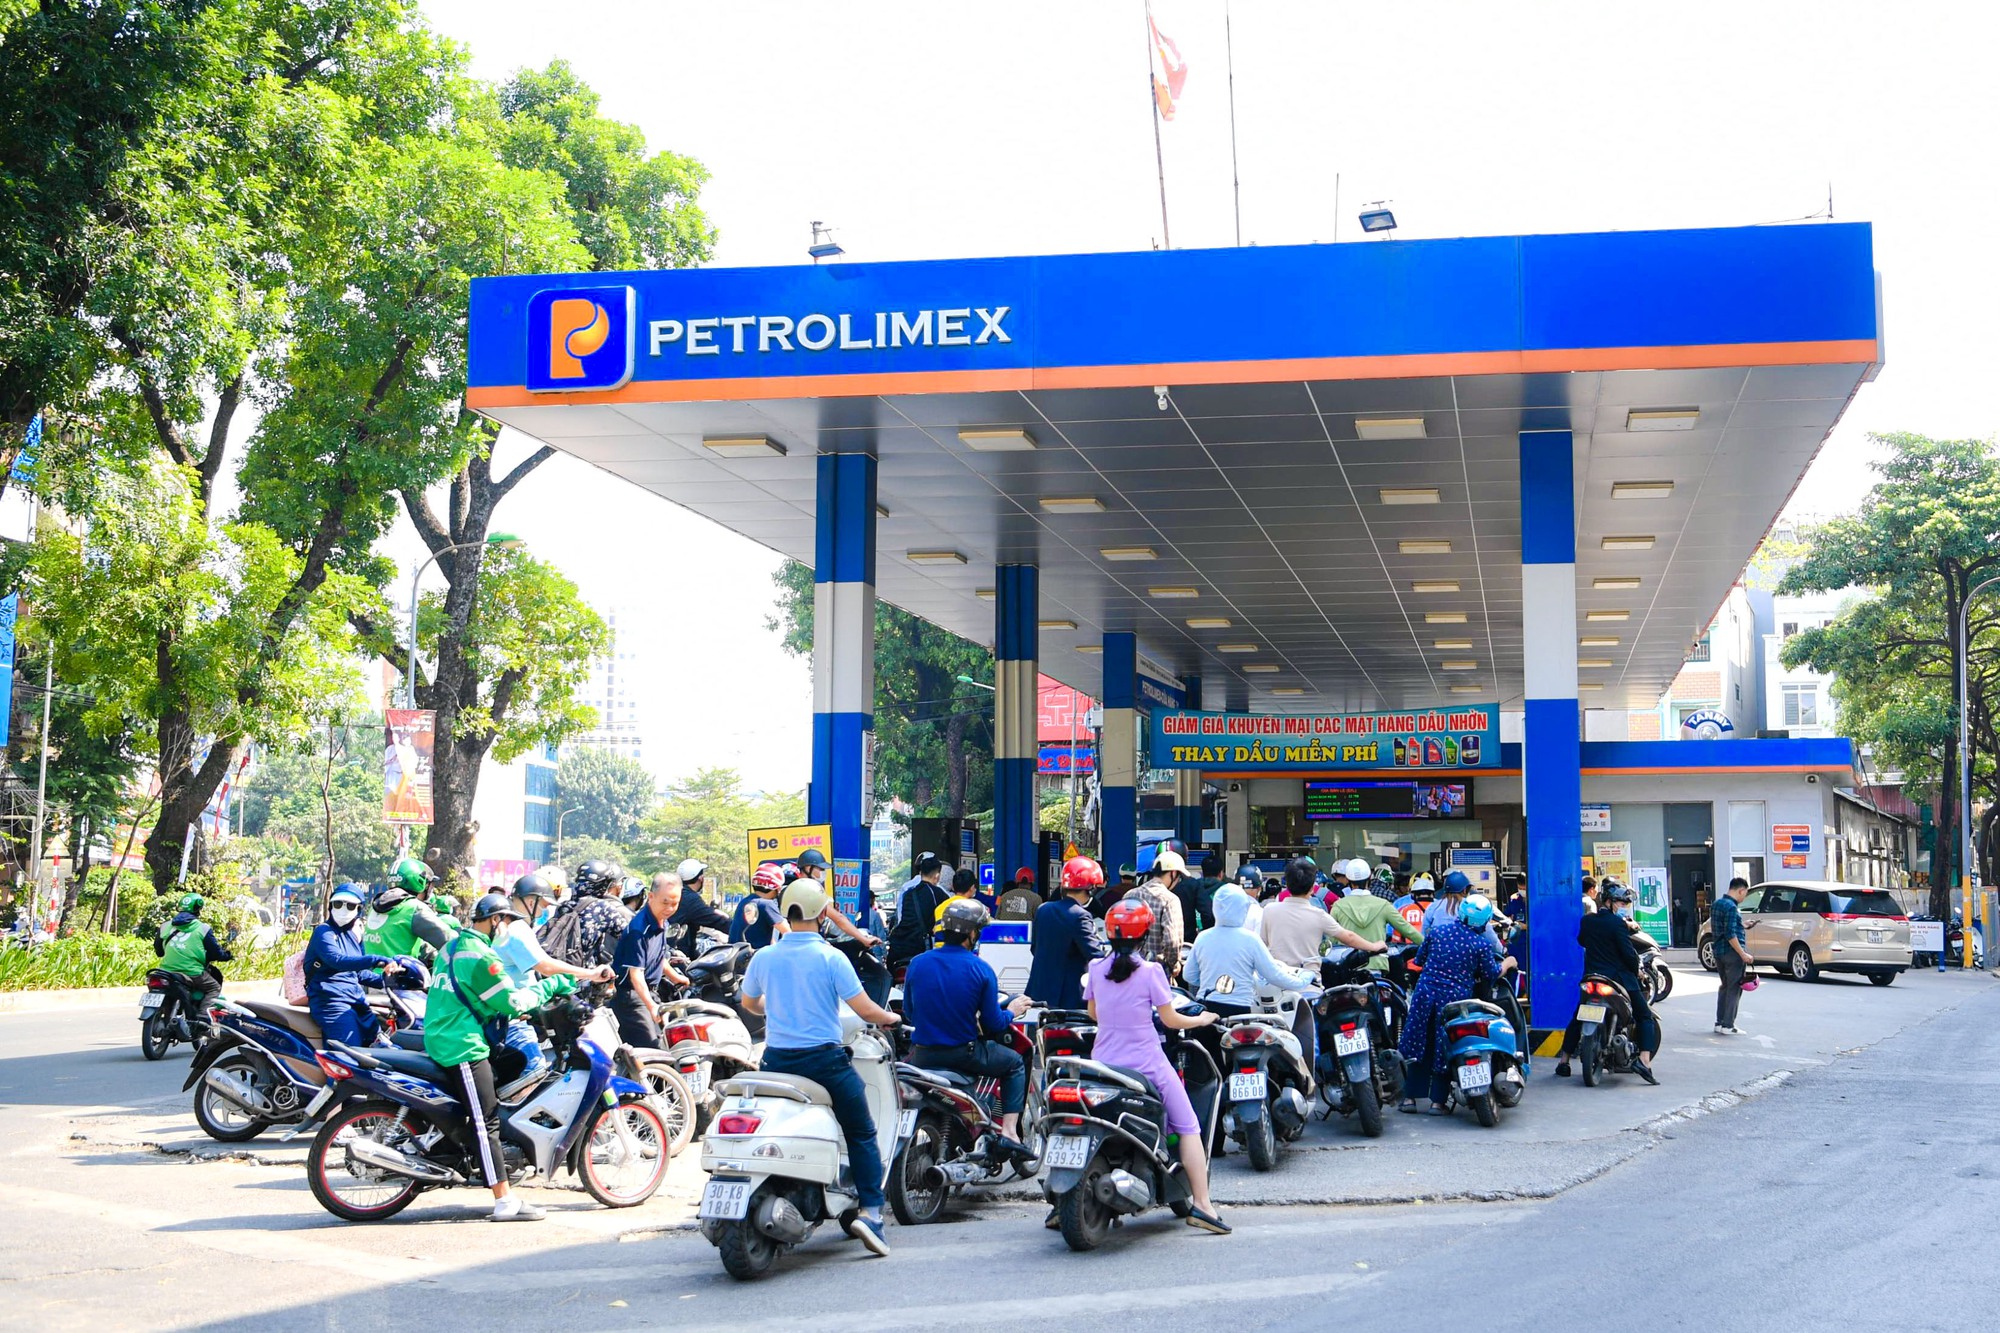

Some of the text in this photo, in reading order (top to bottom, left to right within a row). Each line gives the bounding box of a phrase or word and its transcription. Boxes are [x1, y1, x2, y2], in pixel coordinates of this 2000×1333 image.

[649, 306, 1012, 356] PETROLIMEX
[1163, 712, 1198, 734] GIẢM
[1202, 715, 1225, 734] GIÁ
[1284, 717, 1311, 738] MẠI
[1377, 714, 1415, 733] HÀNG
[1449, 708, 1488, 731] NHỜN
[1171, 746, 1229, 762] THAY
[1285, 738, 1337, 762] MIỄN
[1341, 741, 1378, 762] PHÍ
[757, 836, 822, 849] be CAKE
[1338, 1040, 1367, 1054] 207.66
[1463, 1066, 1485, 1076] 29-E1
[1235, 1075, 1260, 1086] 29-G1
[1461, 1074, 1488, 1087] 520.96
[1053, 1137, 1083, 1150] 29-L1
[1046, 1152, 1084, 1165] 639.25
[710, 1184, 744, 1199] 30-K8
[708, 1200, 740, 1216] 1881
